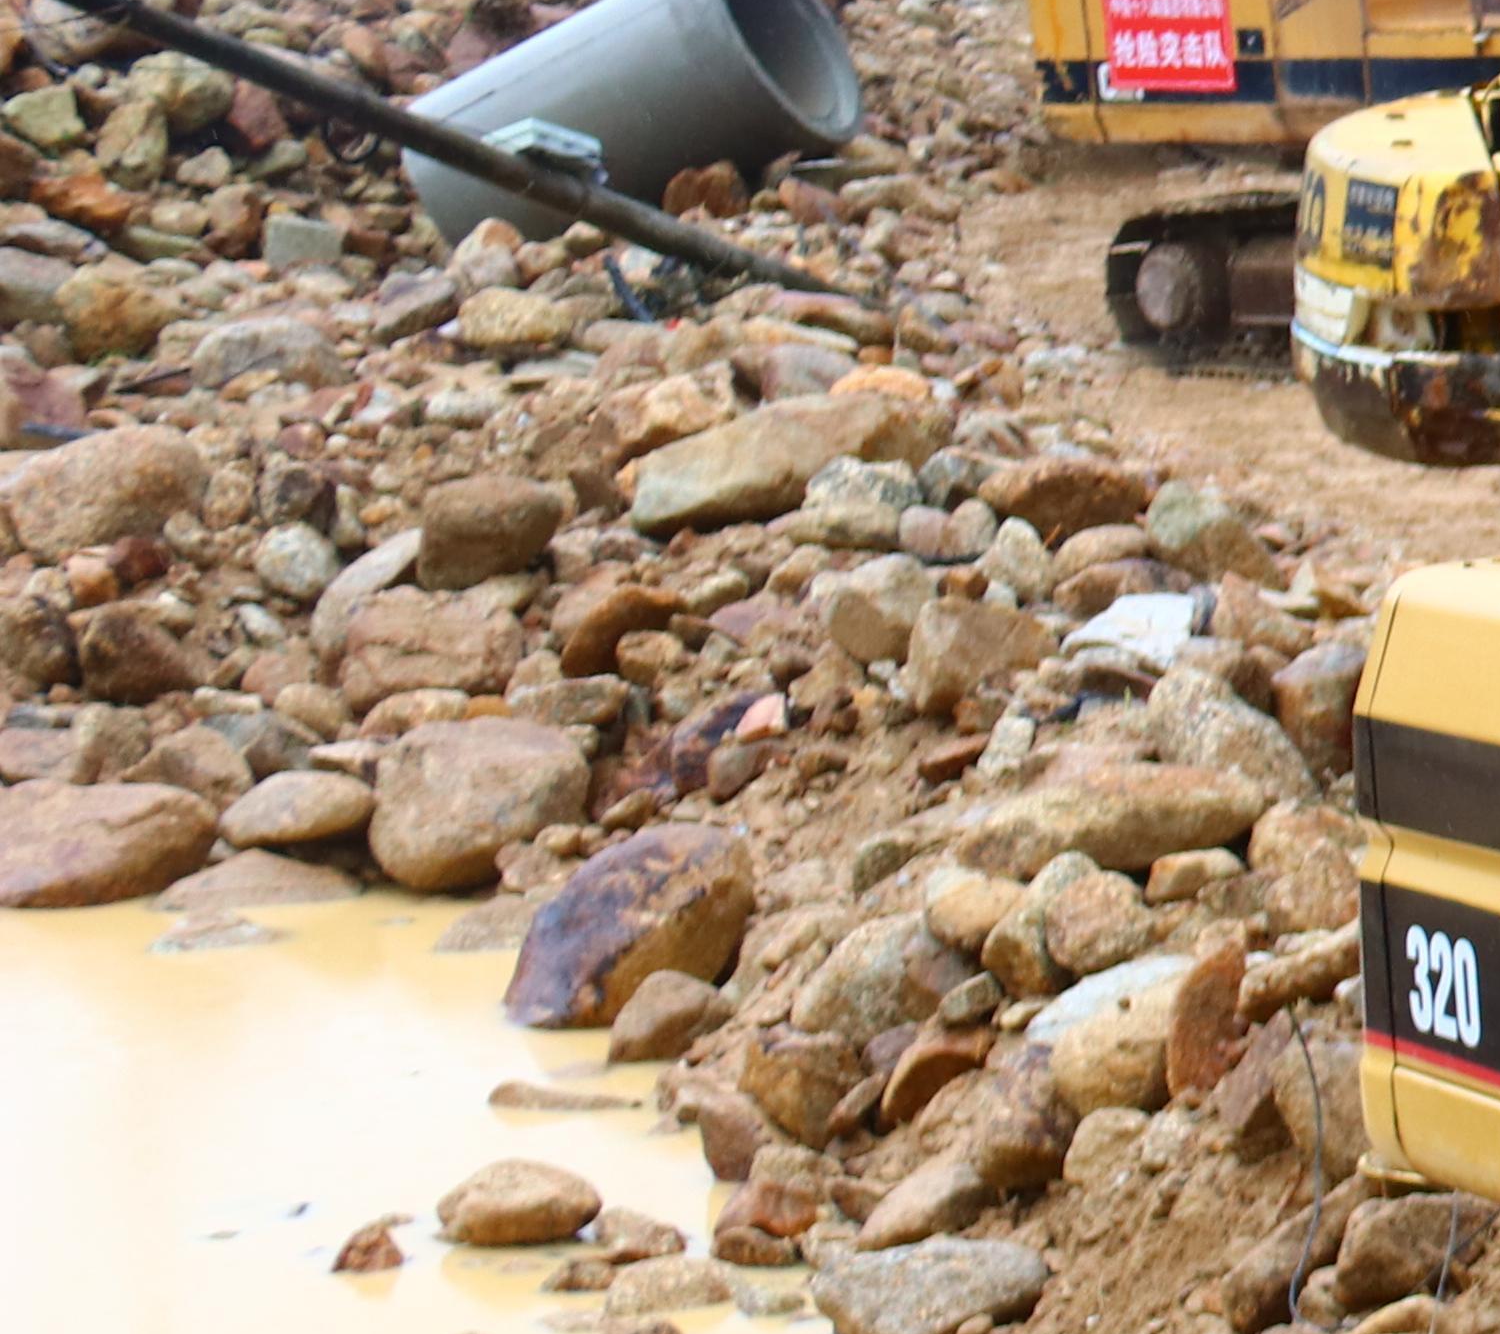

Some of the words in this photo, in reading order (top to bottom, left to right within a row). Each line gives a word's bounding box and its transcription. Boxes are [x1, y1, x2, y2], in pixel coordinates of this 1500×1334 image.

[1112, 29, 1227, 69] 抢险突击队
[1406, 924, 1480, 1048] 320
